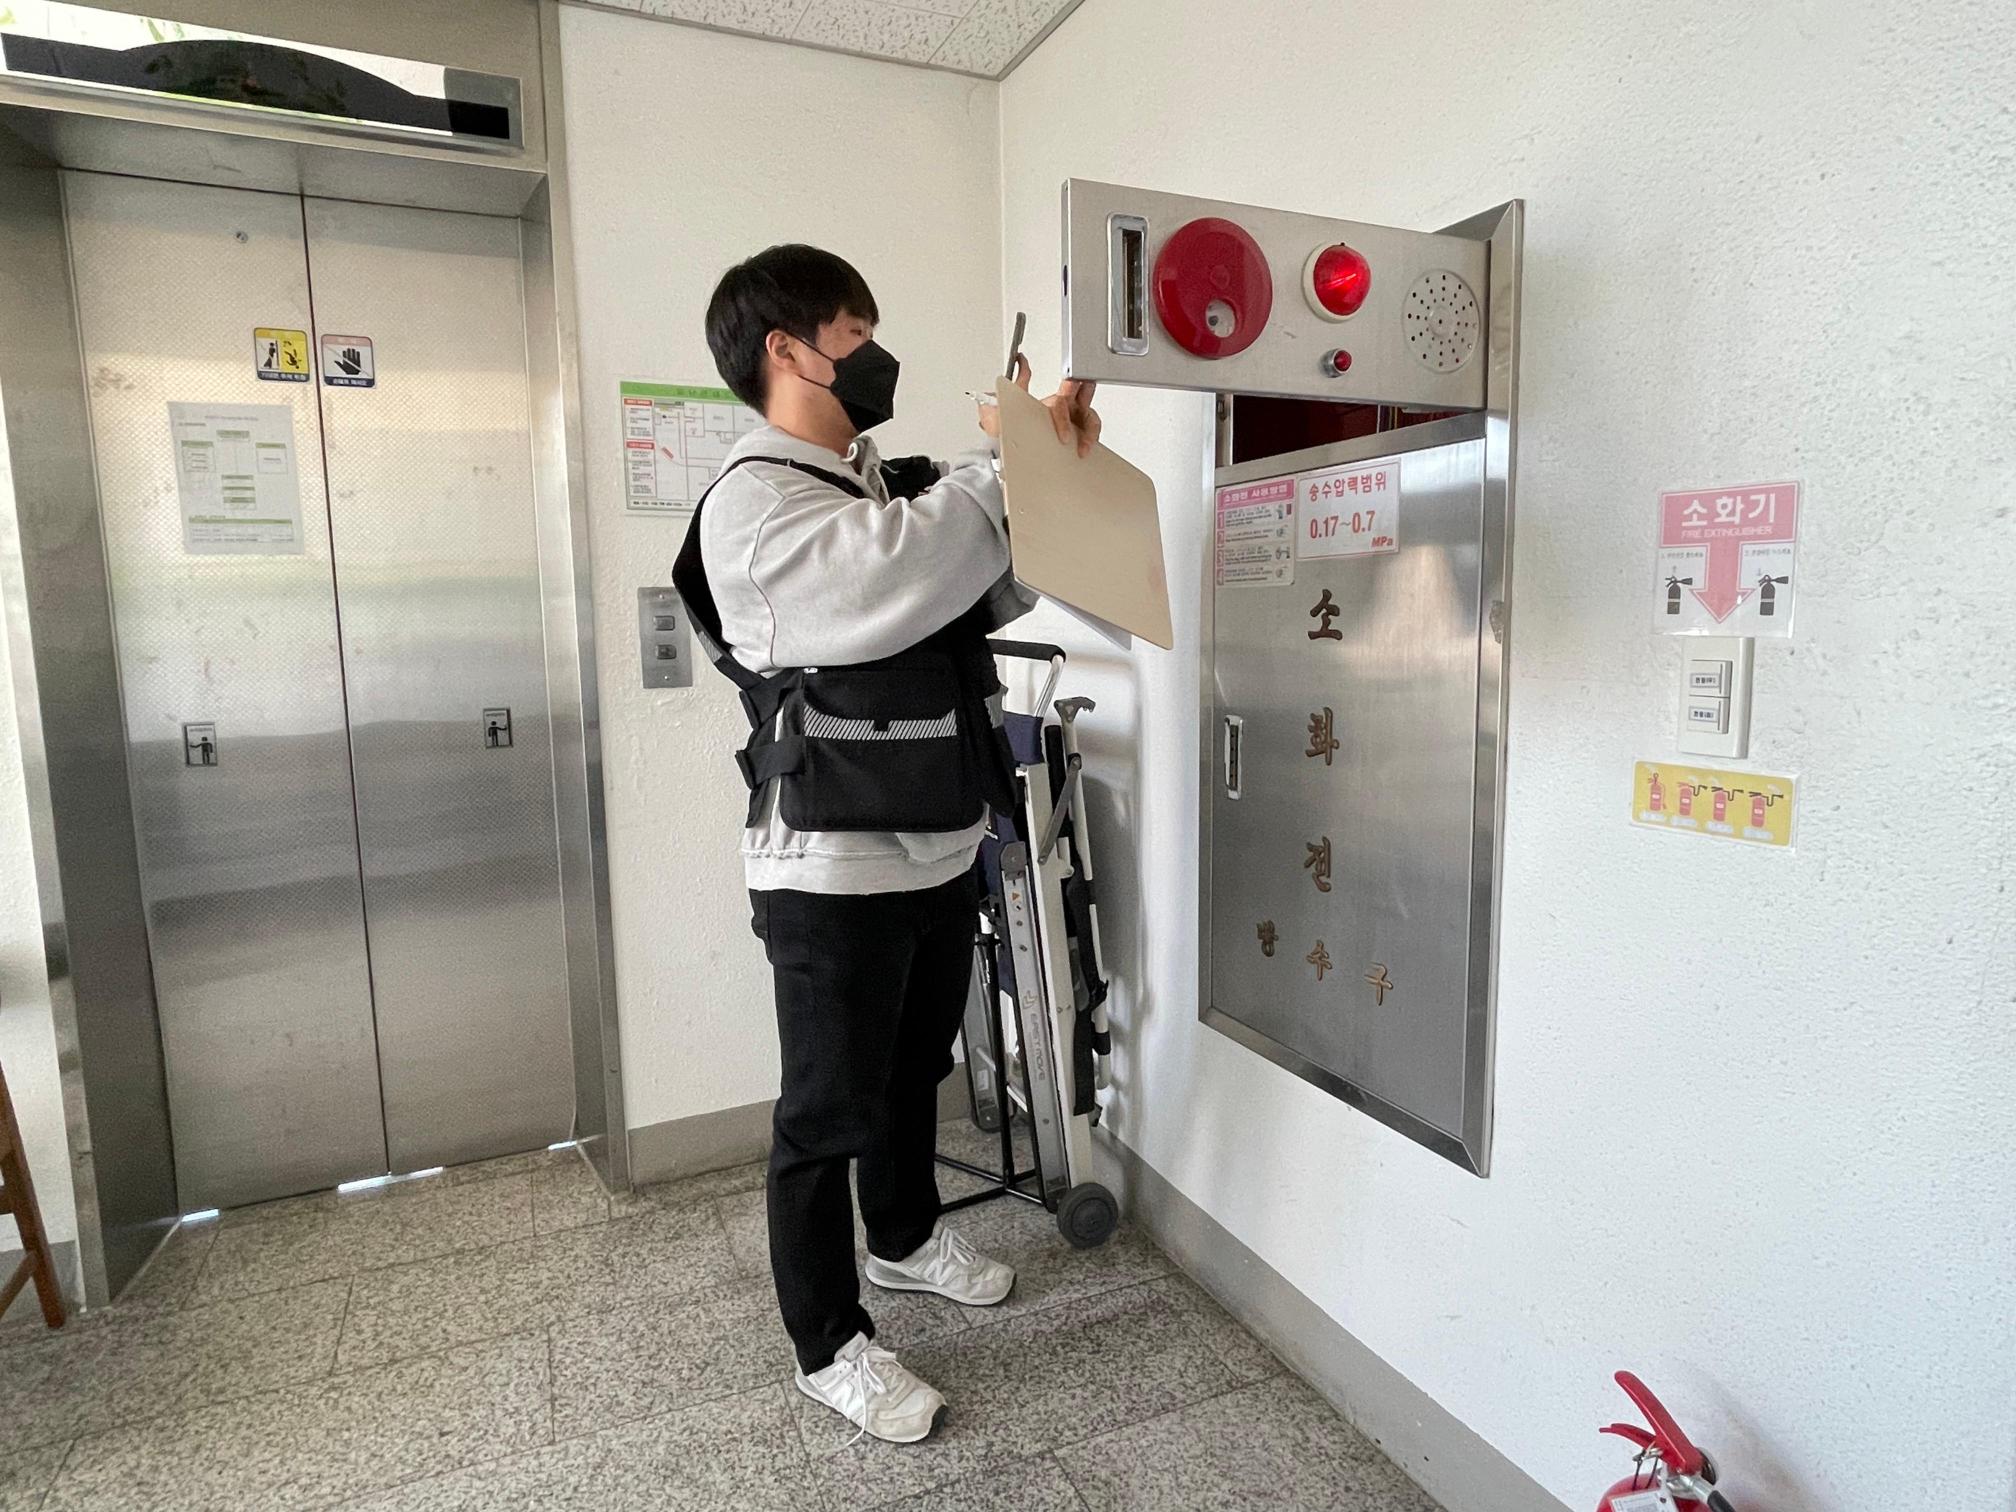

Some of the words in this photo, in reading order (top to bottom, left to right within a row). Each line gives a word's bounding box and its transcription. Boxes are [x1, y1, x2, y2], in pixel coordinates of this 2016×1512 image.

[1309, 471, 1387, 502] 송수압력범위
[1310, 510, 1375, 539] 0.17~0.7
[1681, 493, 1776, 527] 소화기
[1371, 536, 1394, 548] MPa
